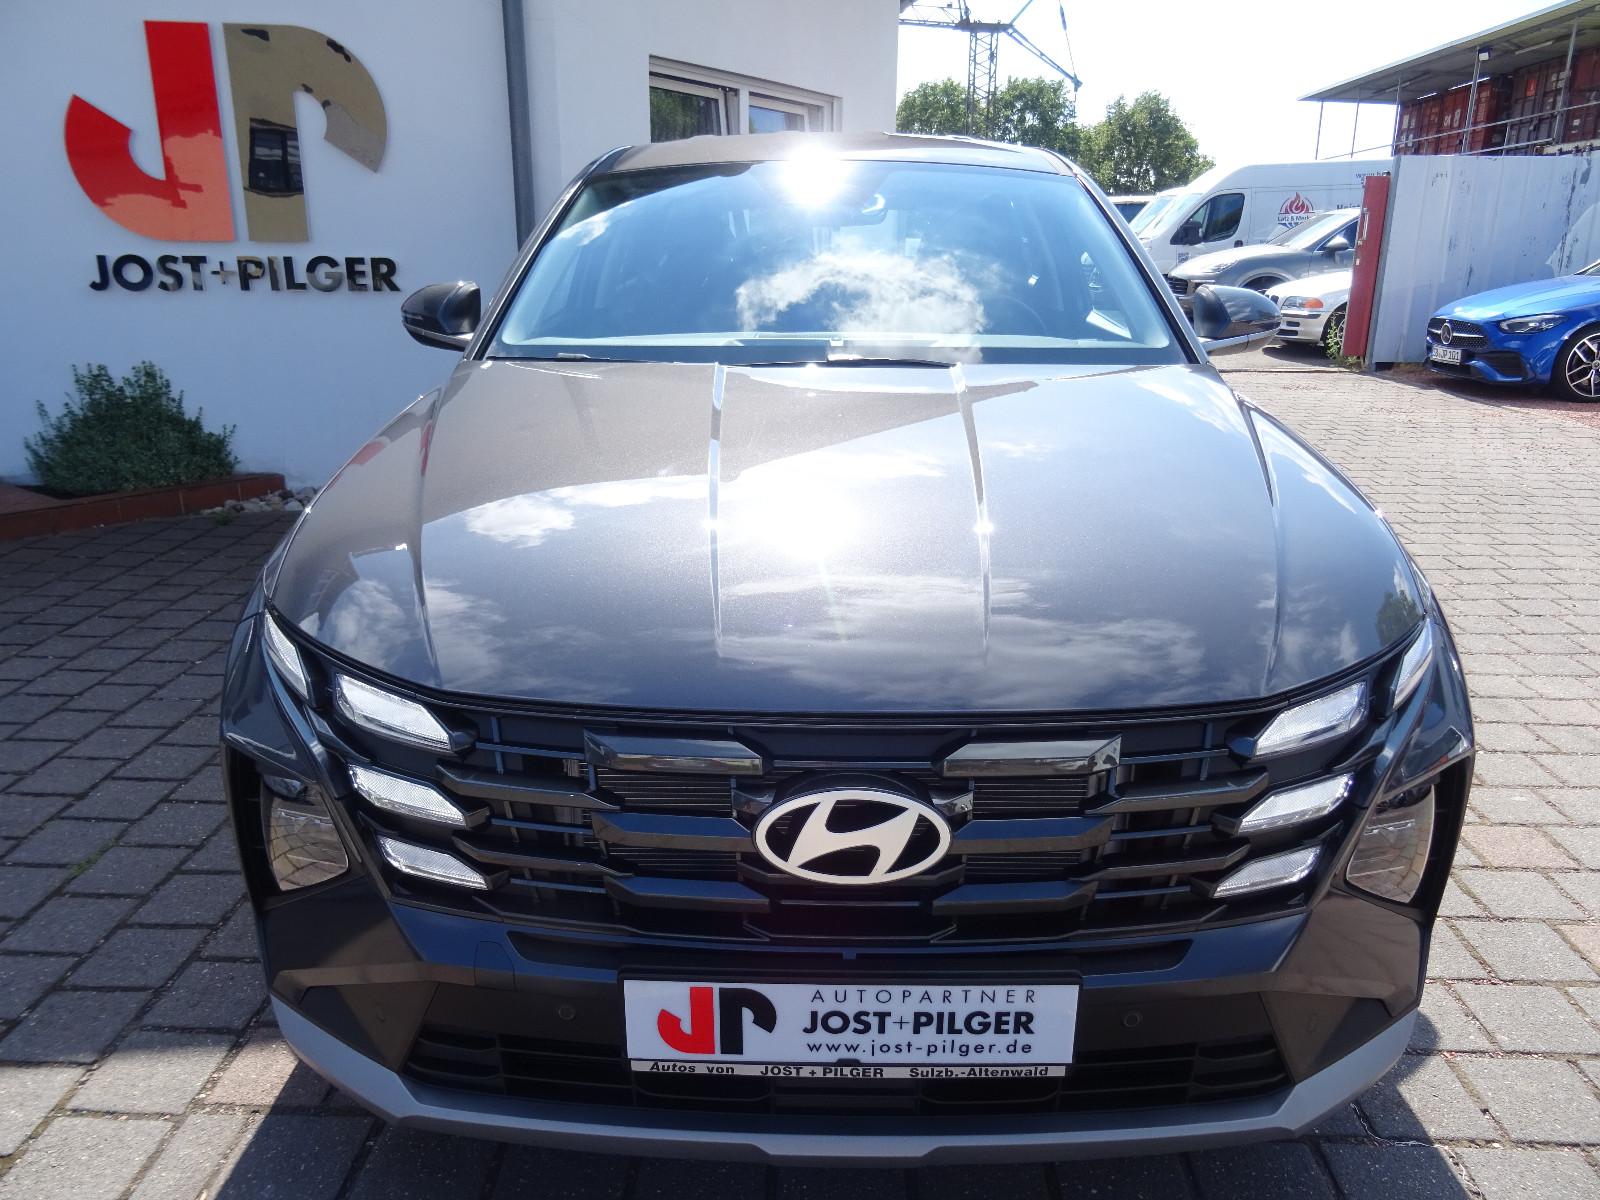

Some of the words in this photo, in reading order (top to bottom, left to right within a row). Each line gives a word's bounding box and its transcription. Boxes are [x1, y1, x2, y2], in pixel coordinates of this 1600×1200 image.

[89, 253, 401, 292] JOST+PILGER
[811, 989, 1036, 1004] AUTOPARTNER
[802, 1010, 1035, 1035] JOST+PILGER
[806, 1039, 1033, 1057] www.jost-pilger.de
[649, 1061, 696, 1073] Autos
[706, 1065, 735, 1074] von
[760, 1065, 803, 1076] JOST
[822, 1066, 884, 1078] PILGER
[909, 1065, 1049, 1078] Sulzb.-Altenwald
